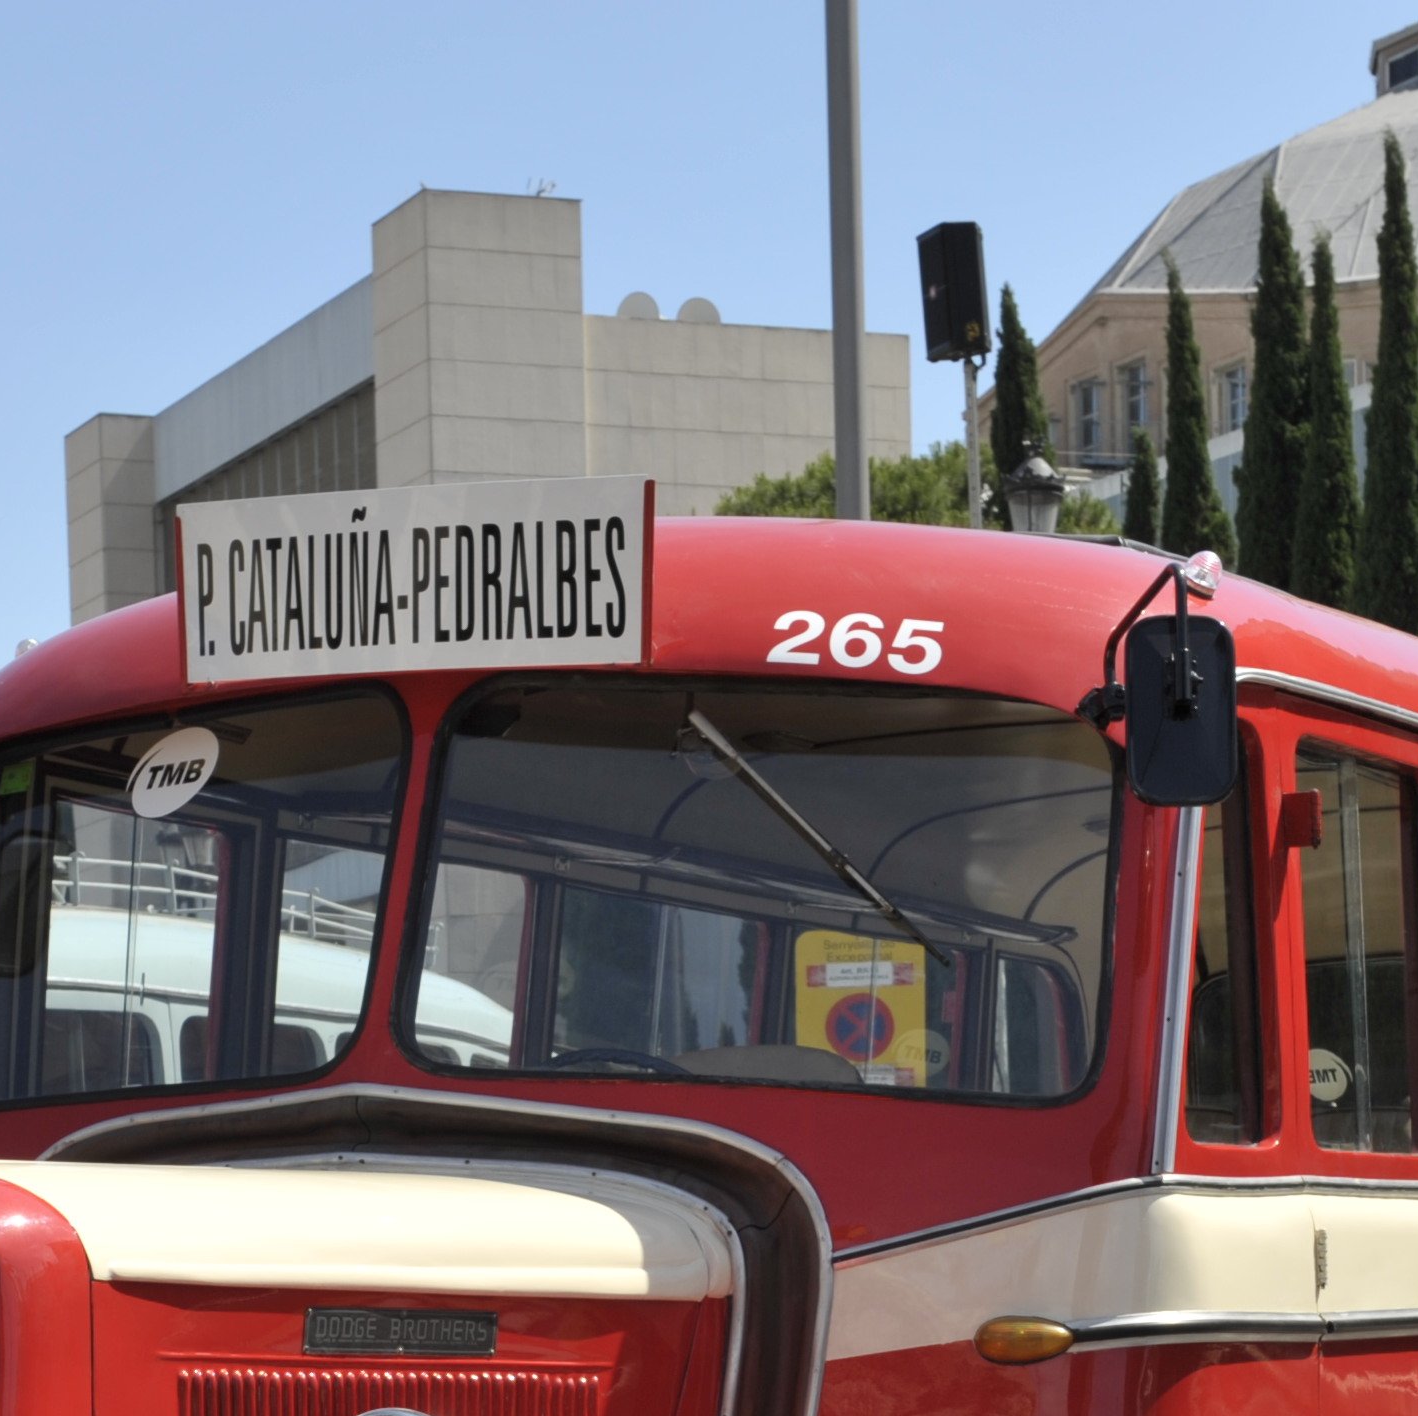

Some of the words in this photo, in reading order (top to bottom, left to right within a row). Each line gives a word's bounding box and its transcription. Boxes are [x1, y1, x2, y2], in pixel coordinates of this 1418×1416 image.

[197, 543, 216, 656] P.
[228, 506, 626, 656] CATALUÑA-PEDRALBES
[766, 610, 944, 675] 265
[146, 758, 206, 790] TMB
[315, 1316, 377, 1338] DODGE
[390, 1318, 488, 1342] BROTHERS
